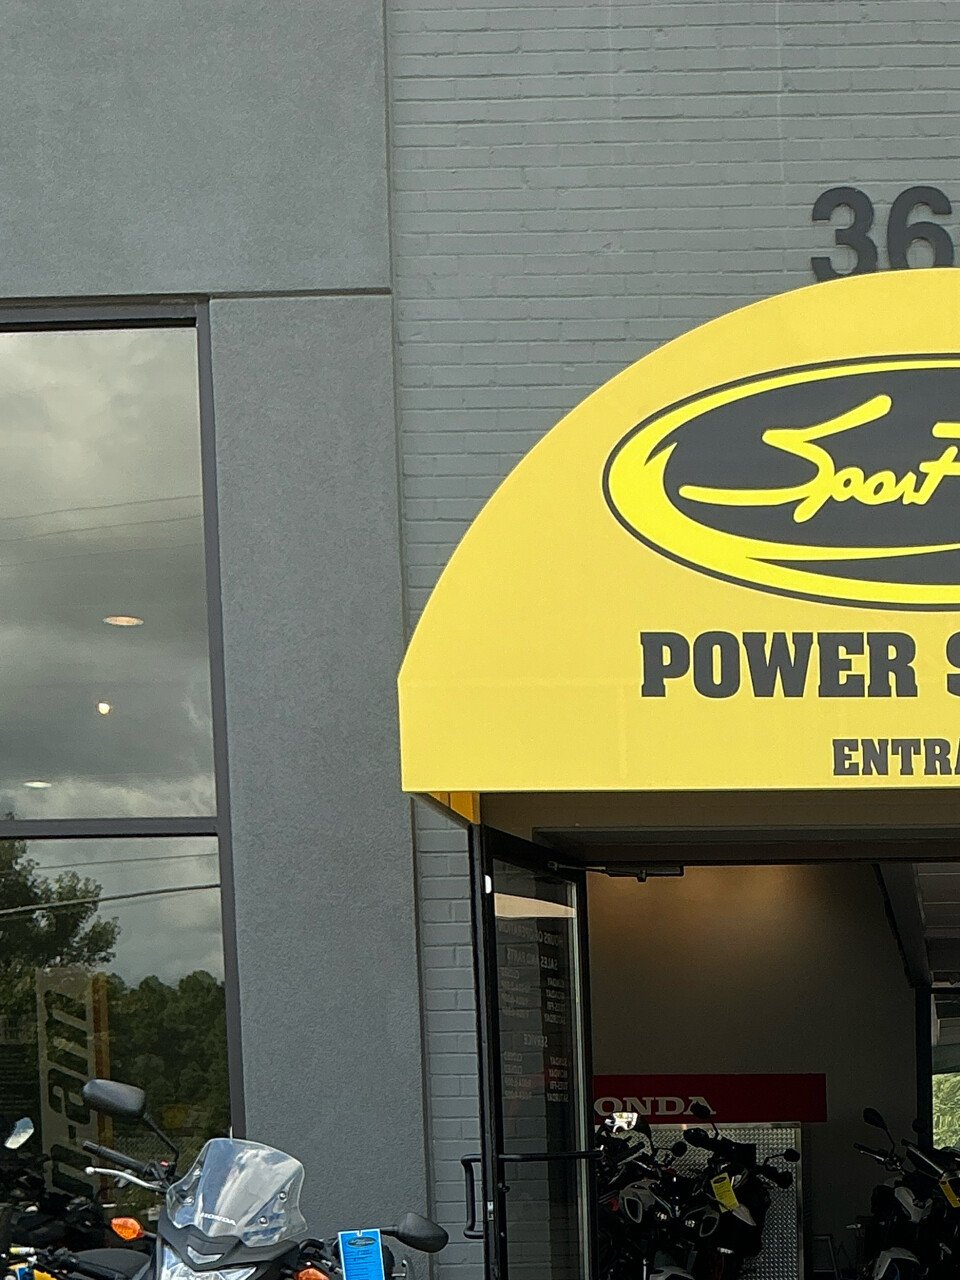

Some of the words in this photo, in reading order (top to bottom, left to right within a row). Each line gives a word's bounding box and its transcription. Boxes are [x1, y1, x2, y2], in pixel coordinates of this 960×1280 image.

[639, 631, 919, 698] POWER
[593, 1096, 717, 1116] ONDA
[200, 1212, 237, 1226] HONDA
